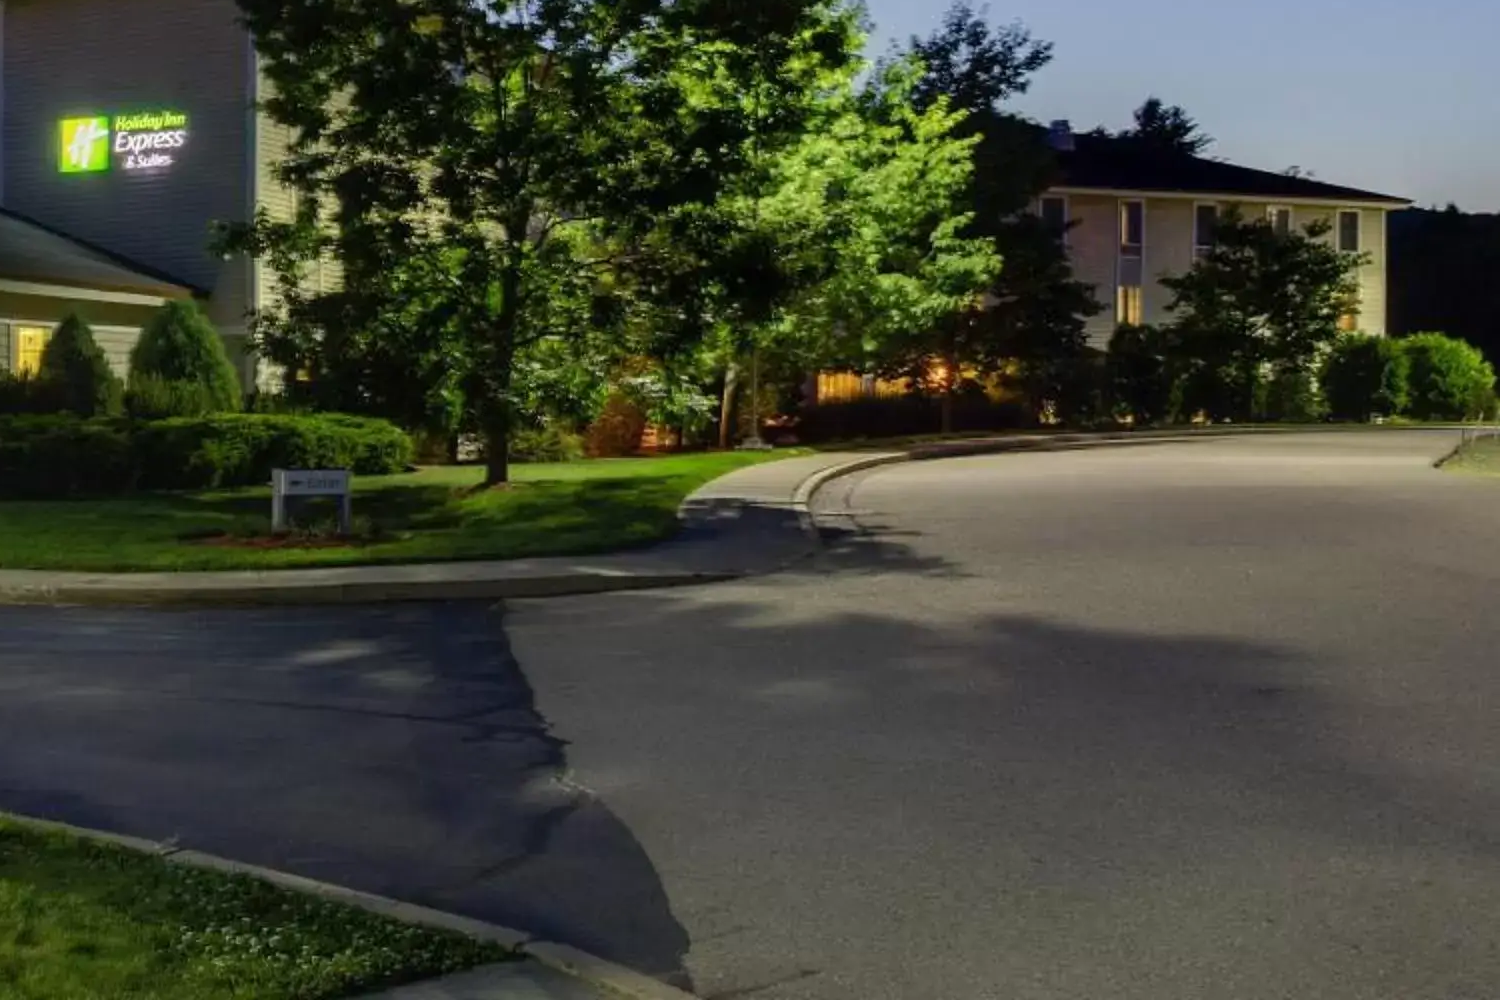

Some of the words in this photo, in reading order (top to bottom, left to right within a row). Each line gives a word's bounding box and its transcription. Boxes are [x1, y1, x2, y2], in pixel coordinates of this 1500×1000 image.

[115, 113, 164, 131] Holiday
[164, 111, 187, 127] Inn
[115, 130, 187, 153] Express
